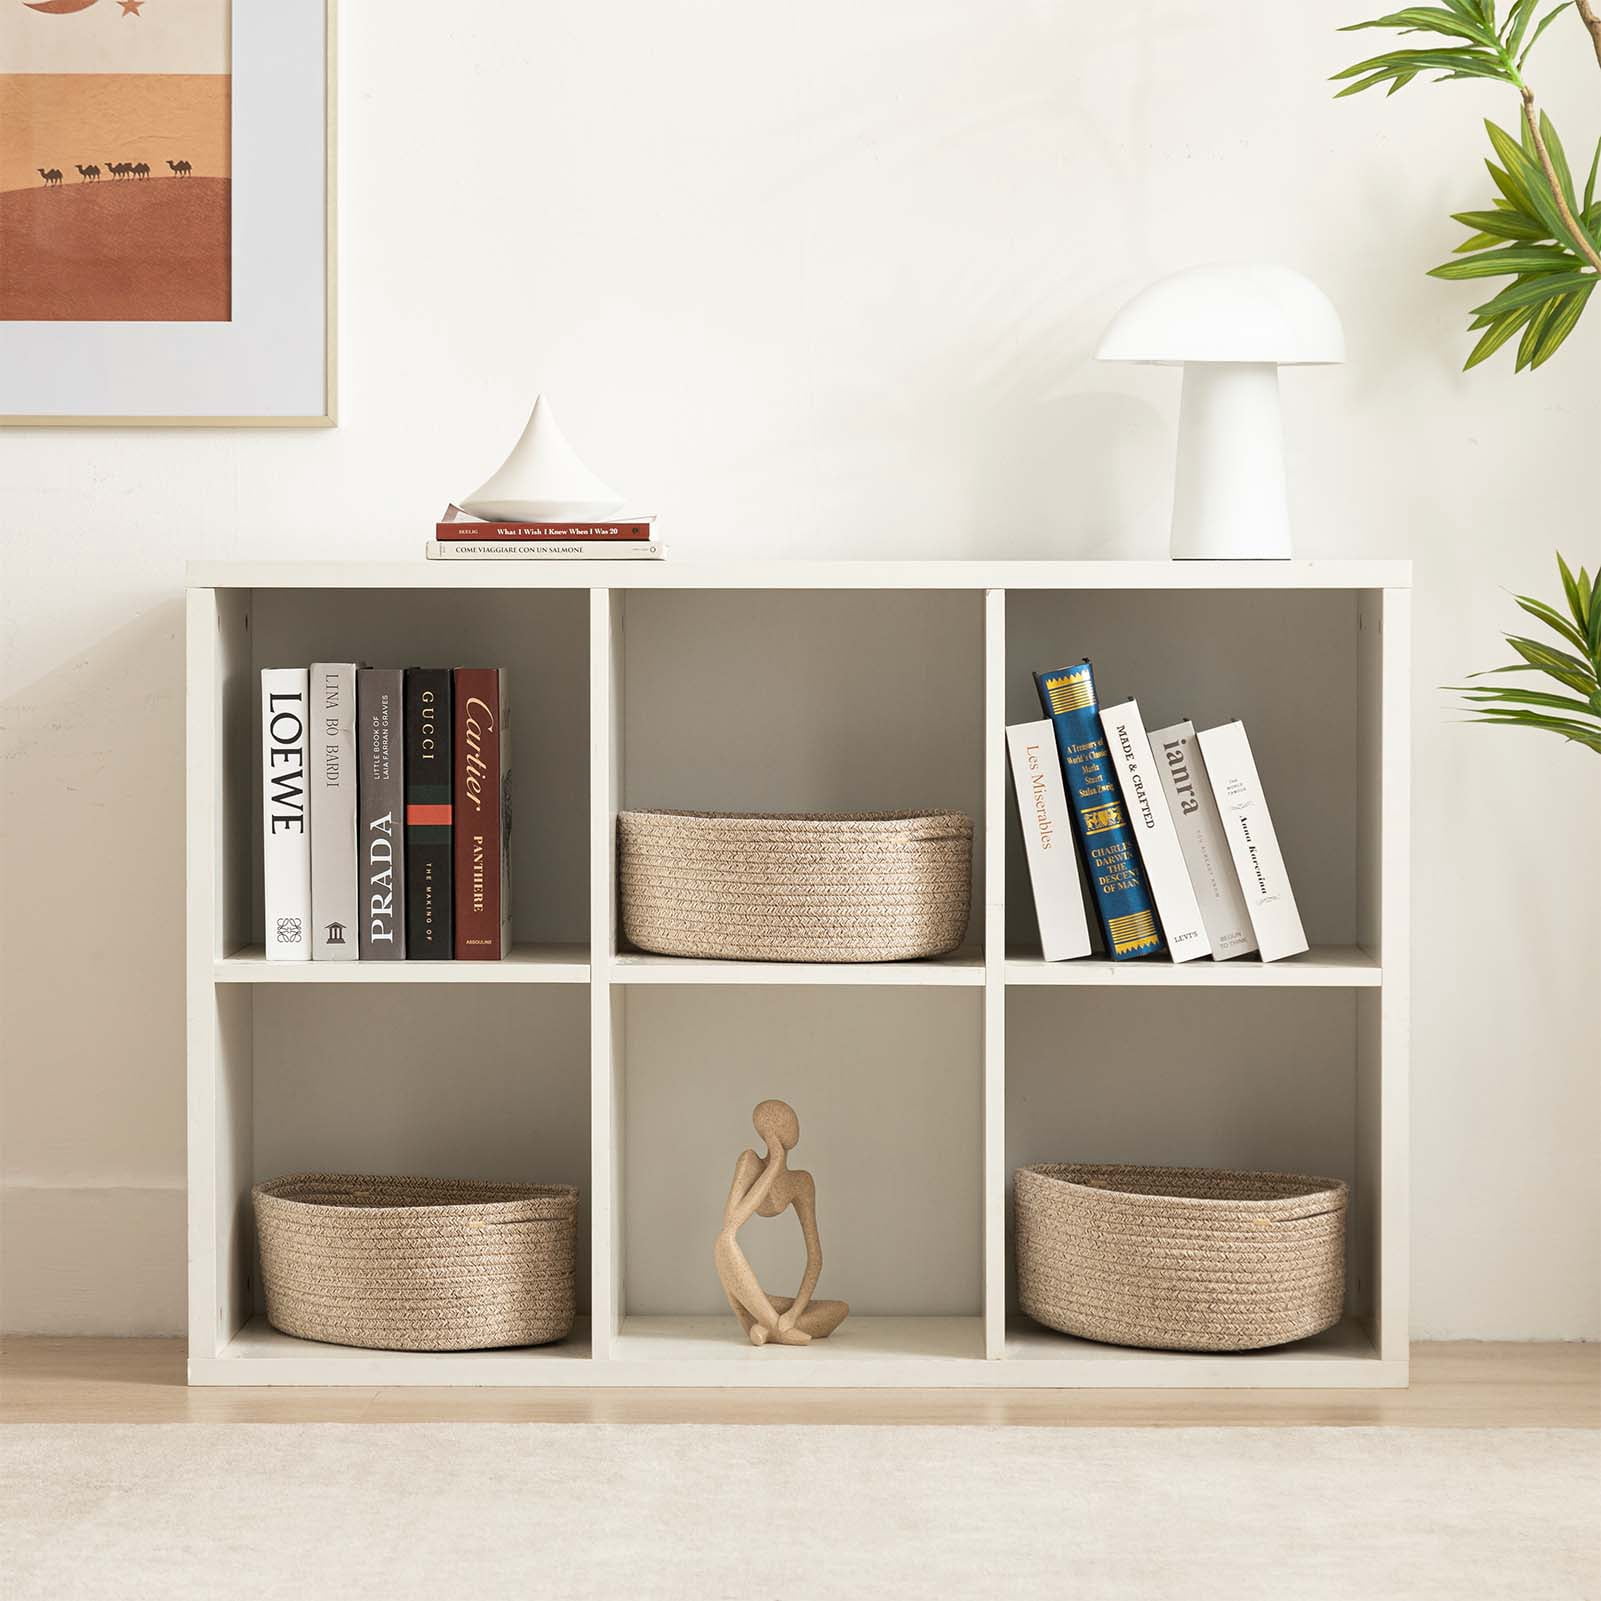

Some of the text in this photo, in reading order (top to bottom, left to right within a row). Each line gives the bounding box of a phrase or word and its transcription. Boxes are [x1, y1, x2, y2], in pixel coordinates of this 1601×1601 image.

[455, 546, 477, 554] COME
[478, 546, 517, 554] VIAGGIARE
[518, 546, 536, 554] CON
[536, 546, 548, 554] UN
[549, 546, 584, 554] SALMONE
[496, 528, 516, 536] What
[523, 528, 542, 536] Wish
[548, 528, 568, 536] Knew
[568, 528, 589, 536] When
[594, 528, 609, 536] Was
[609, 527, 619, 535] 20
[325, 674, 340, 788] LINA BO BARDI
[373, 715, 380, 727] OF
[381, 694, 390, 780] LAIA FARRAN GRAVES
[421, 690, 435, 759] GUCCI
[465, 697, 495, 812] Cartier
[270, 693, 304, 835] LOEWE
[1026, 744, 1054, 851] Les Miserables
[1116, 724, 1155, 829] MADE & CRAFTED
[1163, 739, 1199, 816] ianra
[370, 811, 394, 944] PRADA
[473, 835, 484, 912] PANTHERE
[1103, 884, 1115, 894] OF
[1106, 862, 1128, 874] THE
[1240, 815, 1267, 894] Anna Karenina
[425, 929, 433, 941] OF
